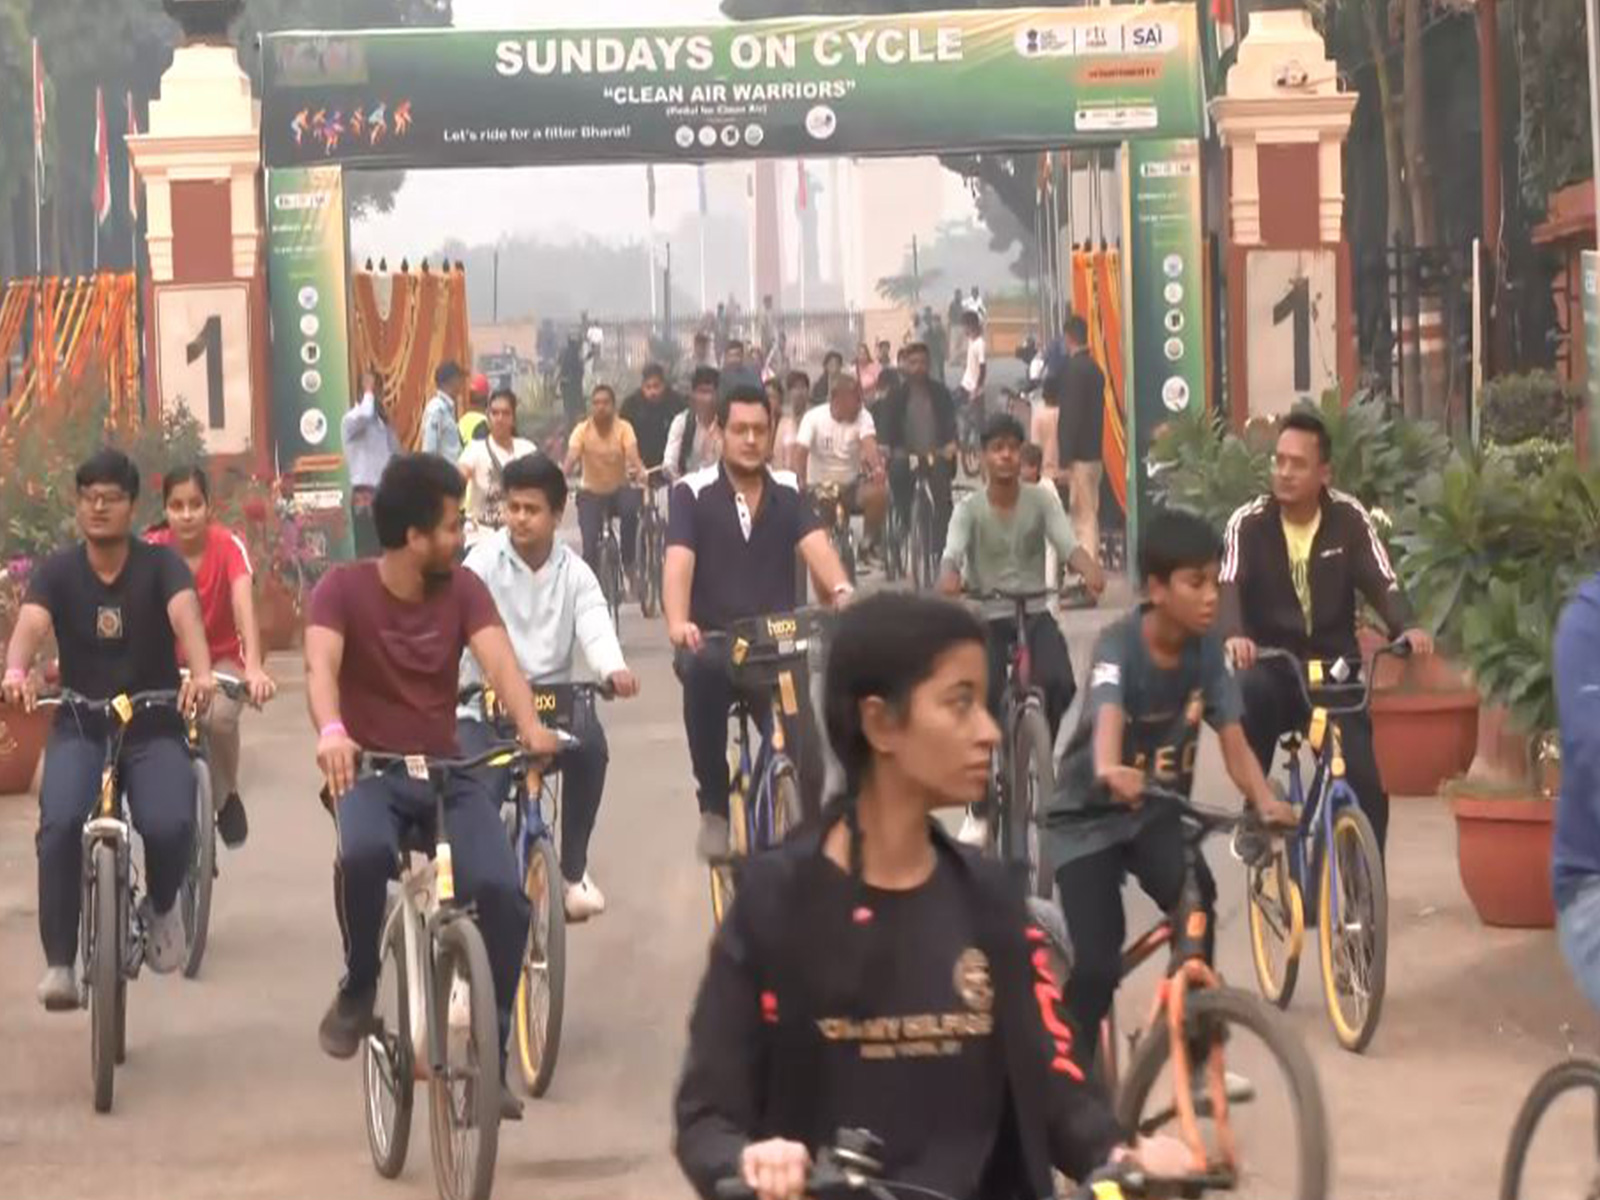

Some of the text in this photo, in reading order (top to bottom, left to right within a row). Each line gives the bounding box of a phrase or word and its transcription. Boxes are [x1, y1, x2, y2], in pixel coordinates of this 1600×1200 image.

[495, 27, 964, 76] SUNDAYS ON CYCLE
[1132, 25, 1163, 46] SAI
[690, 84, 727, 102] AIR
[443, 128, 478, 142] Let's
[480, 127, 508, 141] ride
[510, 126, 531, 140] for
[533, 131, 542, 140] a
[581, 123, 632, 139] Bharat!
[1273, 275, 1311, 391] 1
[186, 315, 225, 429] 1
